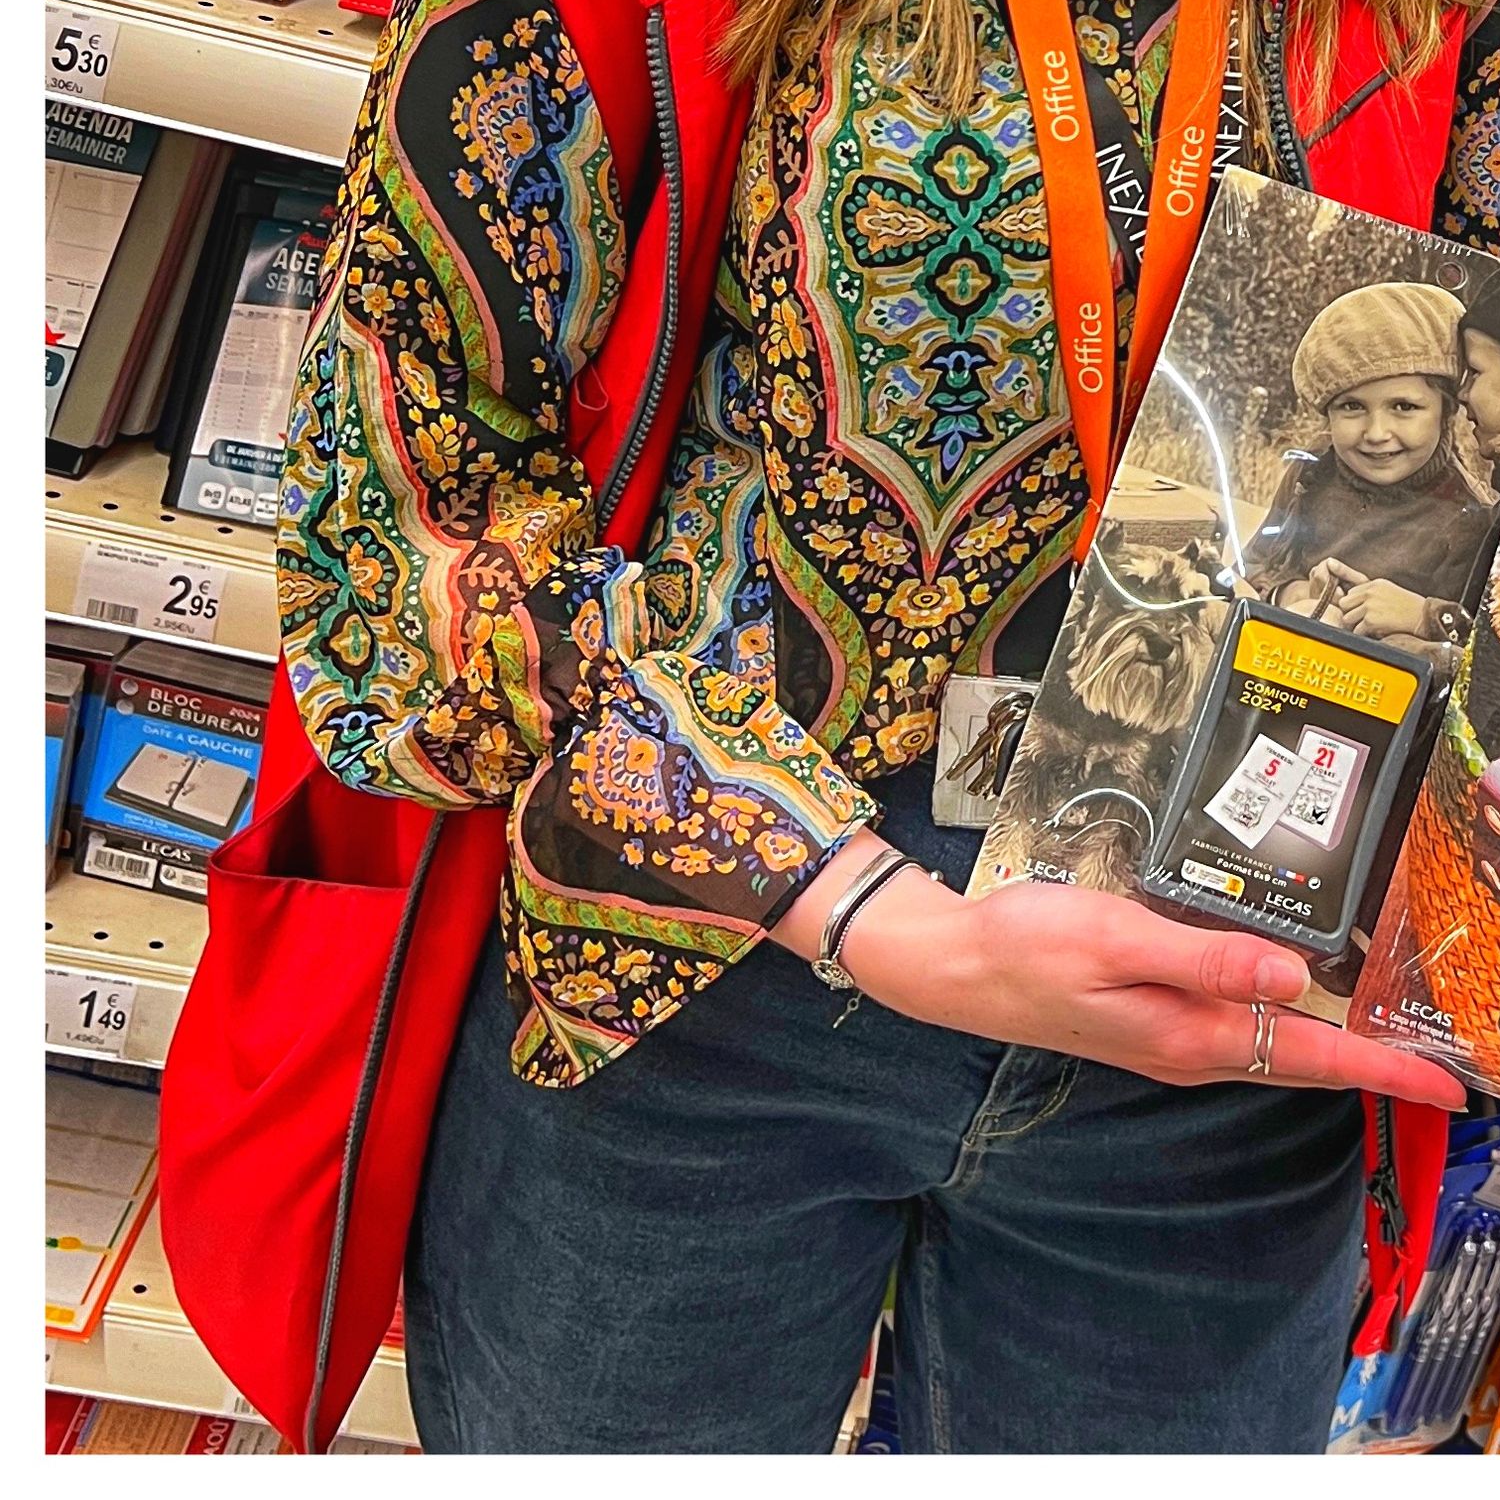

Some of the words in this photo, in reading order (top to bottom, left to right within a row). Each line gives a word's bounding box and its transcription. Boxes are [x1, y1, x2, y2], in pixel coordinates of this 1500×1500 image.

[1047, 49, 1079, 143] Office
[1167, 123, 1205, 217] Office
[1076, 301, 1103, 394] Office
[1256, 640, 1386, 694] CALENDRIER
[150, 687, 202, 709] BLOC
[1239, 692, 1283, 715] 2024
[1244, 679, 1308, 710] COMIQUE
[147, 701, 172, 717] DE
[180, 709, 260, 739] BUREAU
[1264, 758, 1279, 777] 5
[1314, 747, 1334, 768] 21
[1025, 858, 1078, 885] LECAS
[1216, 857, 1252, 878] Format
[1272, 878, 1288, 888] cm
[1400, 997, 1453, 1029] LECAS
